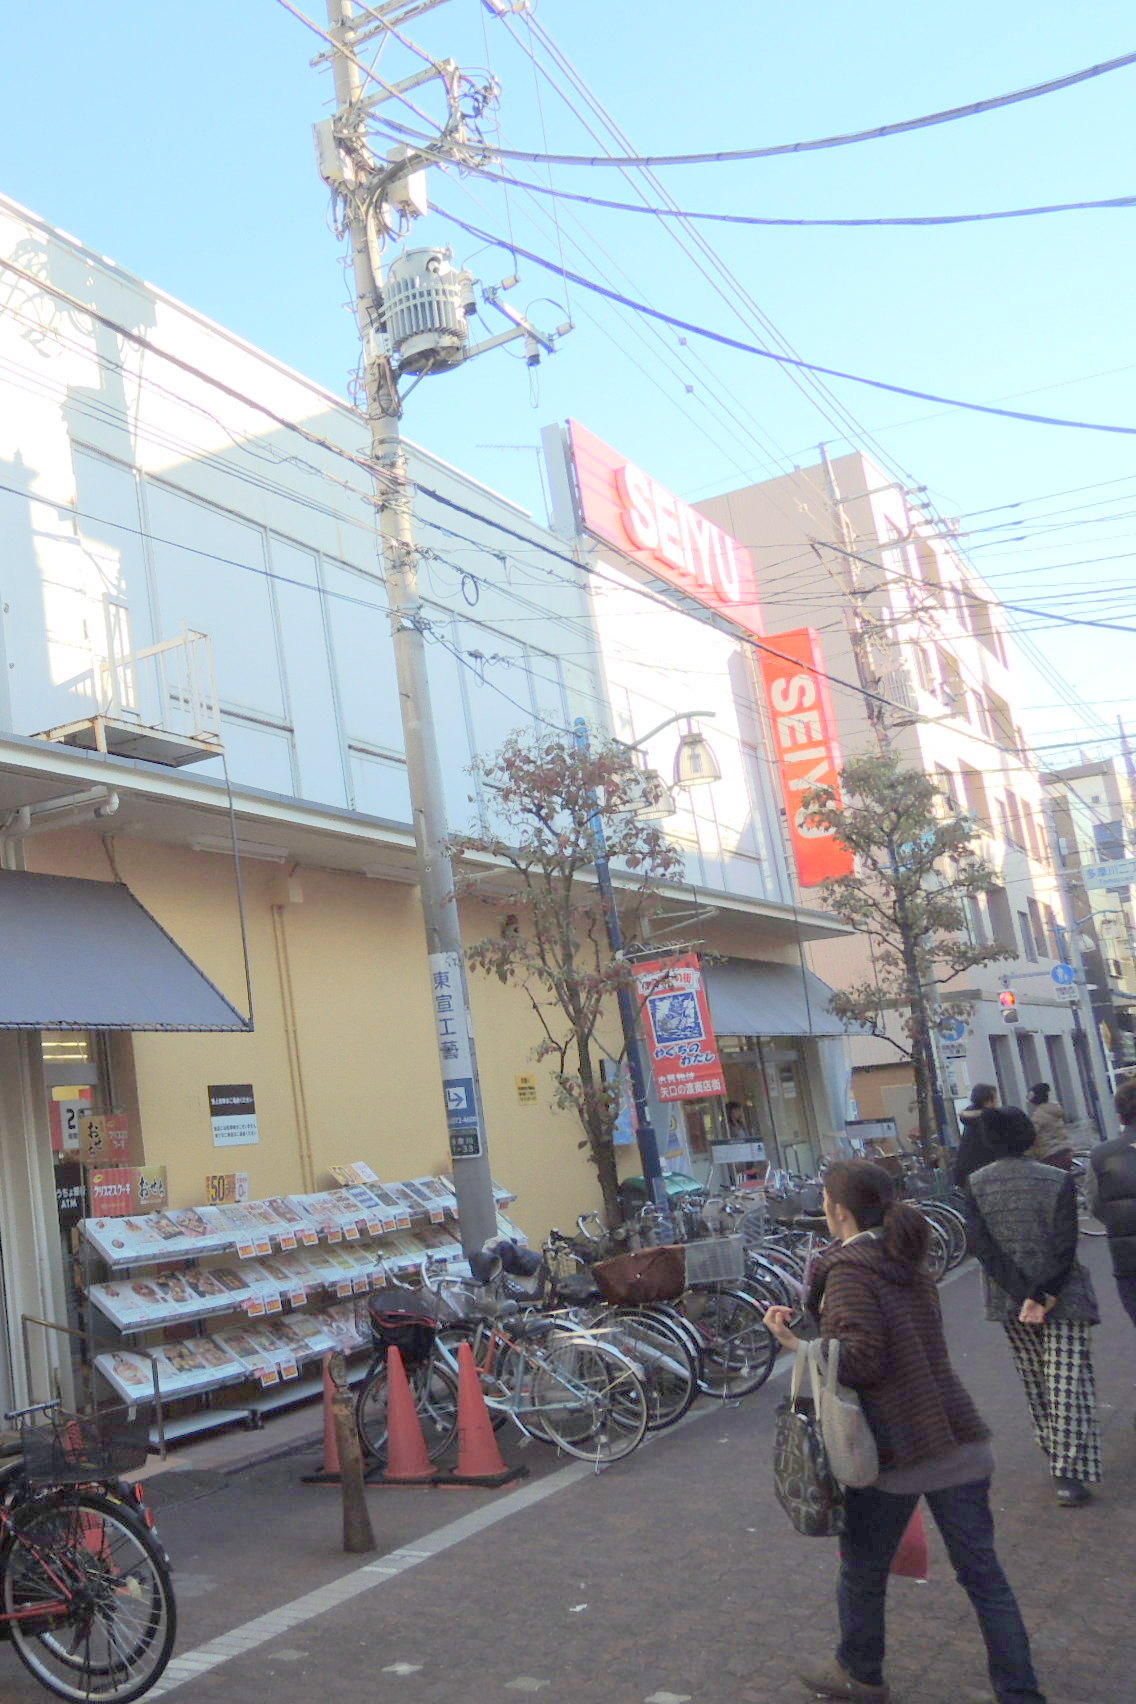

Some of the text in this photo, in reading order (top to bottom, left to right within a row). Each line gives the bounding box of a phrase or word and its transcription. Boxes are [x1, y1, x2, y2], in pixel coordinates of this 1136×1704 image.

[615, 464, 741, 602] SEIYU
[655, 1044, 700, 1058] やくちの
[681, 1053, 714, 1066] わたし
[94, 1183, 131, 1197] クリスマスケーキ
[61, 1199, 77, 1208] ATM
